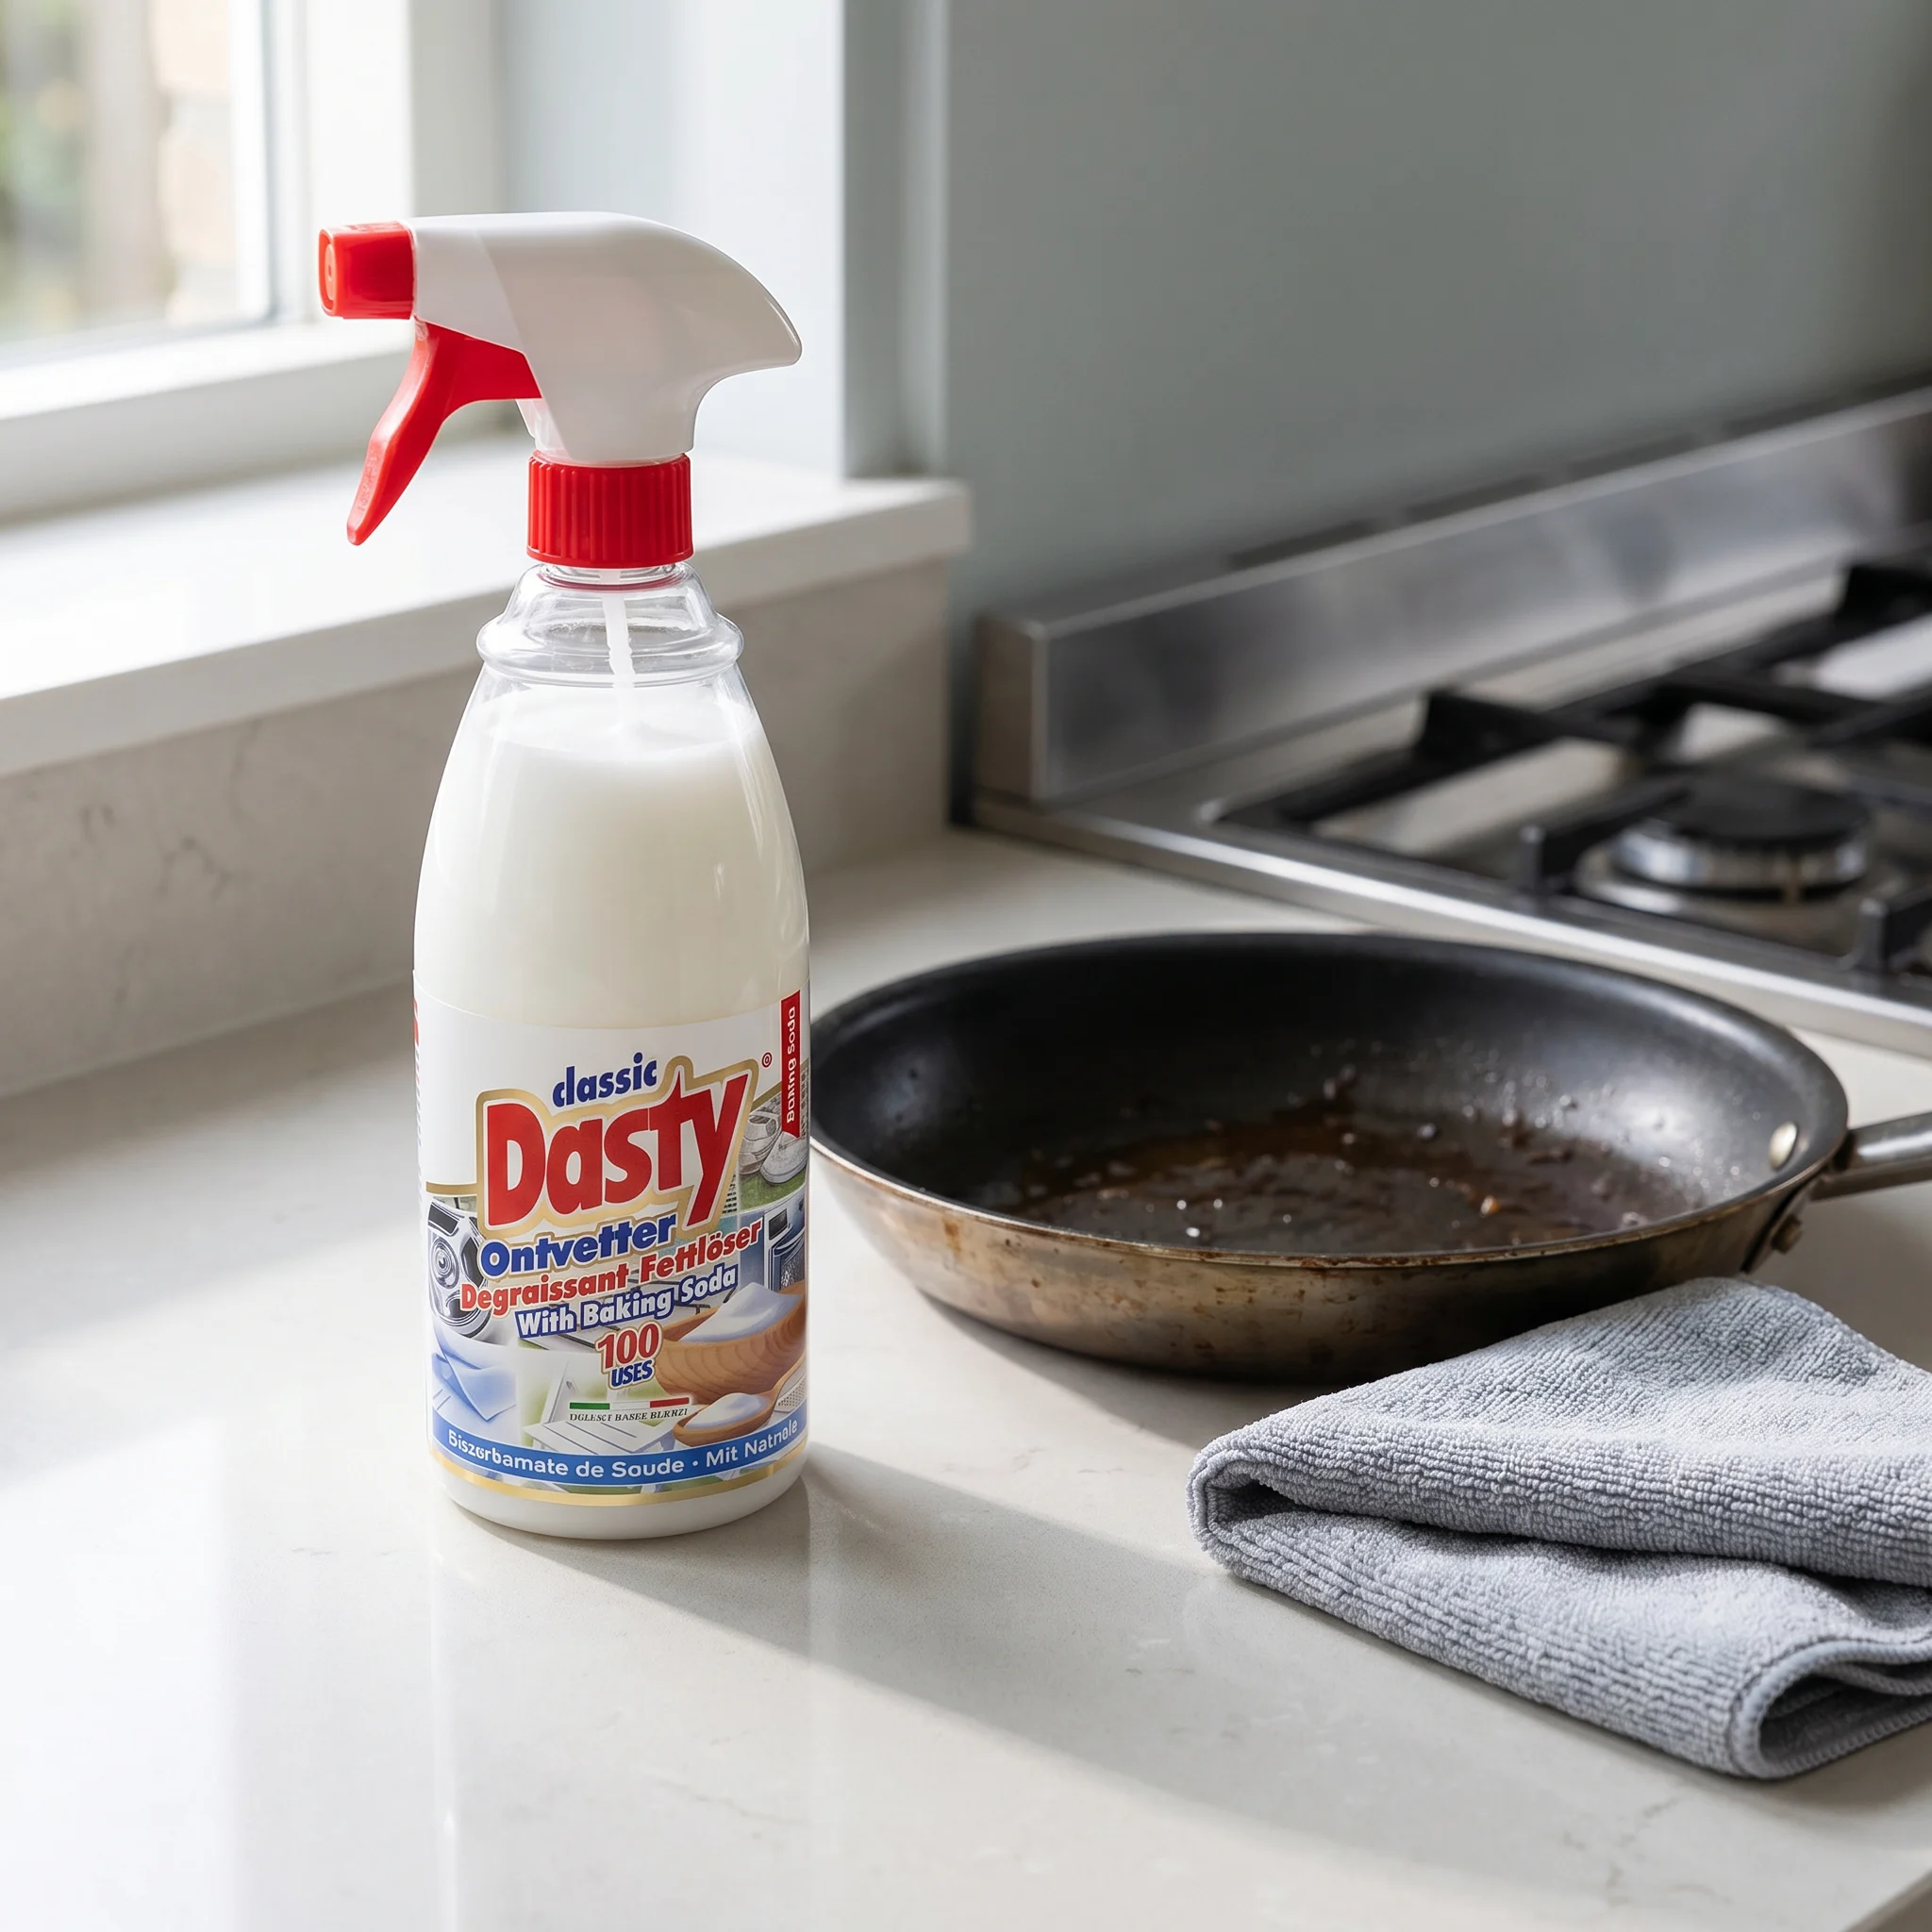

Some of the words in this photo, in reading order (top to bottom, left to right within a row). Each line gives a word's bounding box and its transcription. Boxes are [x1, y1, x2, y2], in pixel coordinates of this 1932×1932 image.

[552, 1052, 658, 1108] classic
[486, 1069, 750, 1227] Dasty
[460, 1262, 629, 1316] Degraissant
[640, 1221, 762, 1283] Fettlöser
[480, 1213, 676, 1277] Ontvetter
[518, 1307, 575, 1336] With
[584, 1290, 672, 1325] Baking
[681, 1264, 737, 1300] Soda
[597, 1323, 659, 1369] 100
[610, 1359, 653, 1388] USES
[575, 1460, 605, 1478] de
[611, 1457, 685, 1478] Soude
[706, 1446, 738, 1467] Mit
